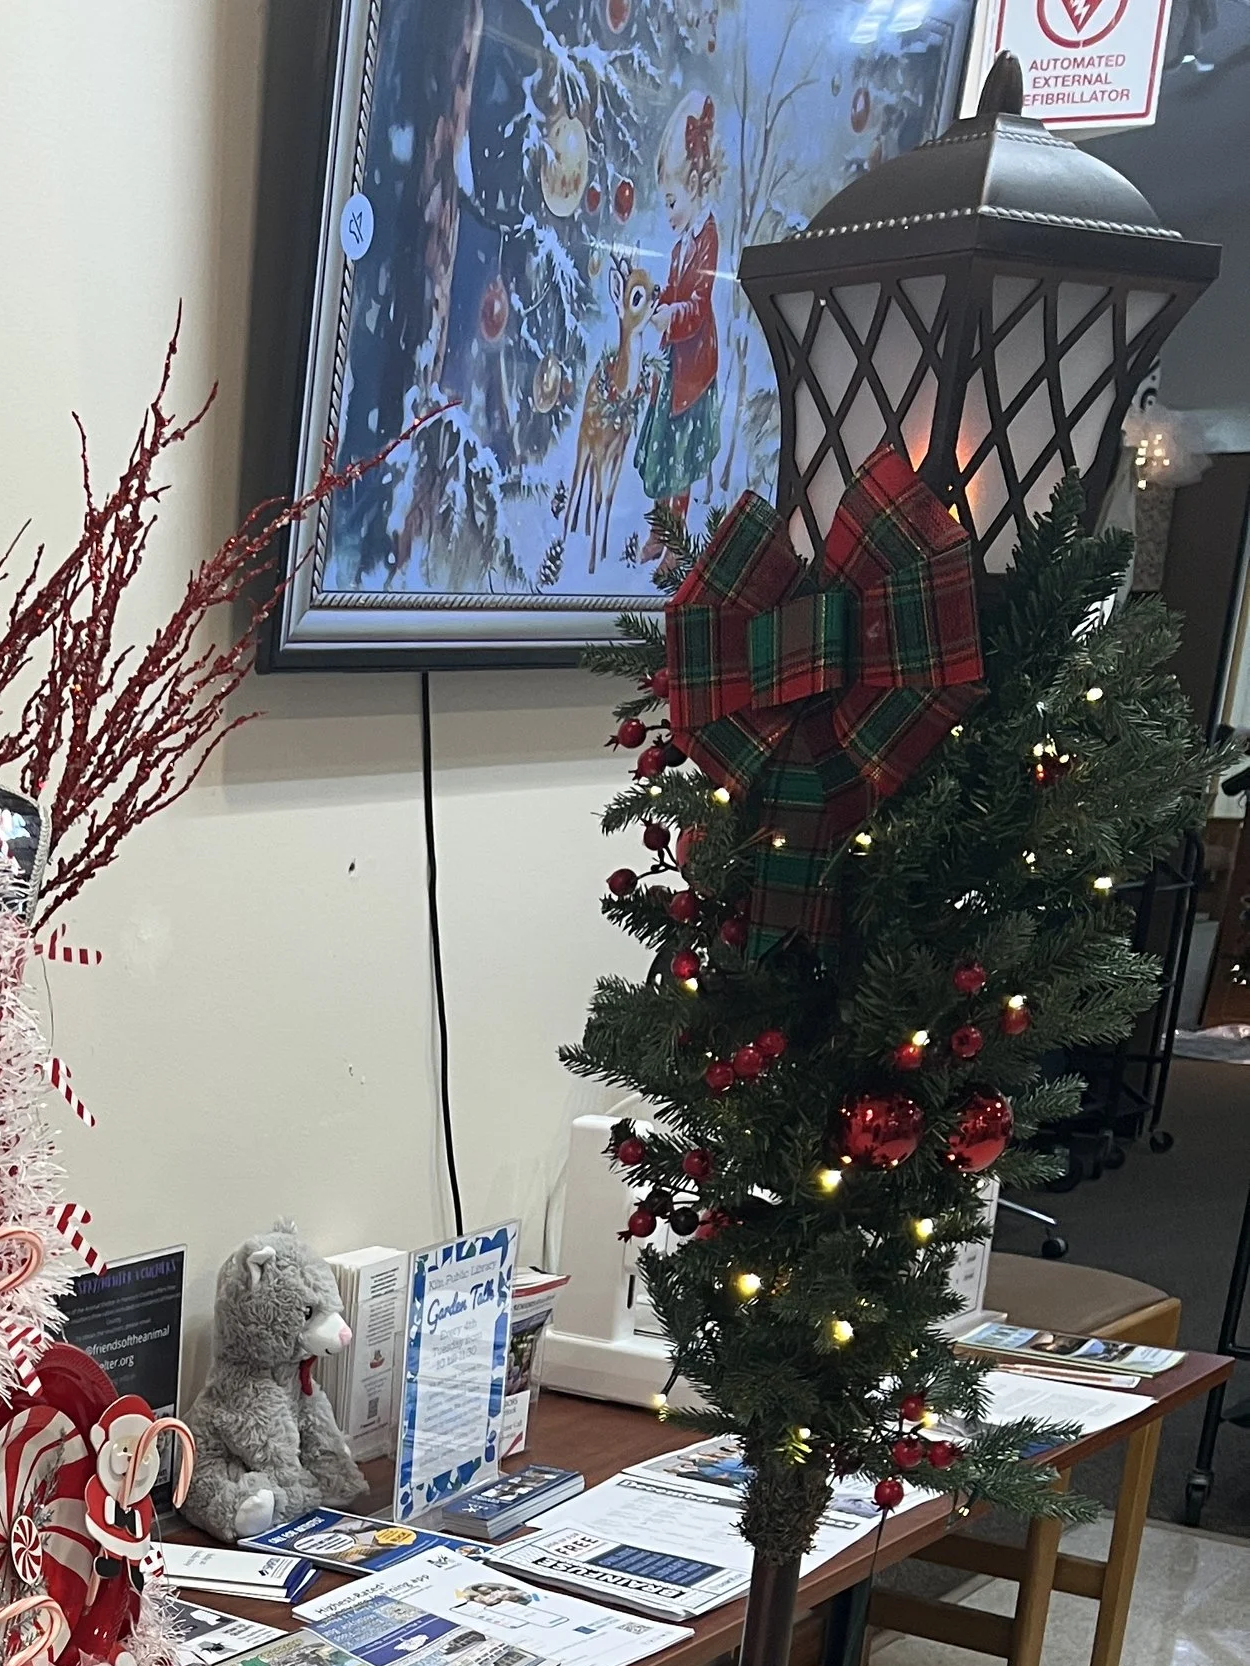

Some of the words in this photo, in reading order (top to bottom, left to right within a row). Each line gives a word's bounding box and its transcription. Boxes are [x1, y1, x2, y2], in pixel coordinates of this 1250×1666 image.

[1029, 54, 1126, 72] AUTOMATED
[1032, 74, 1113, 88] EXTERNAL
[1022, 89, 1130, 107] EFIBRILLATOR
[427, 1291, 468, 1334] Garden
[470, 1278, 495, 1310] Talk
[85, 1325, 170, 1355] @friendsoftheanimal
[98, 1354, 135, 1371] elter.org
[555, 1536, 599, 1556] FREE
[533, 1557, 687, 1598] BRAINFUSE
